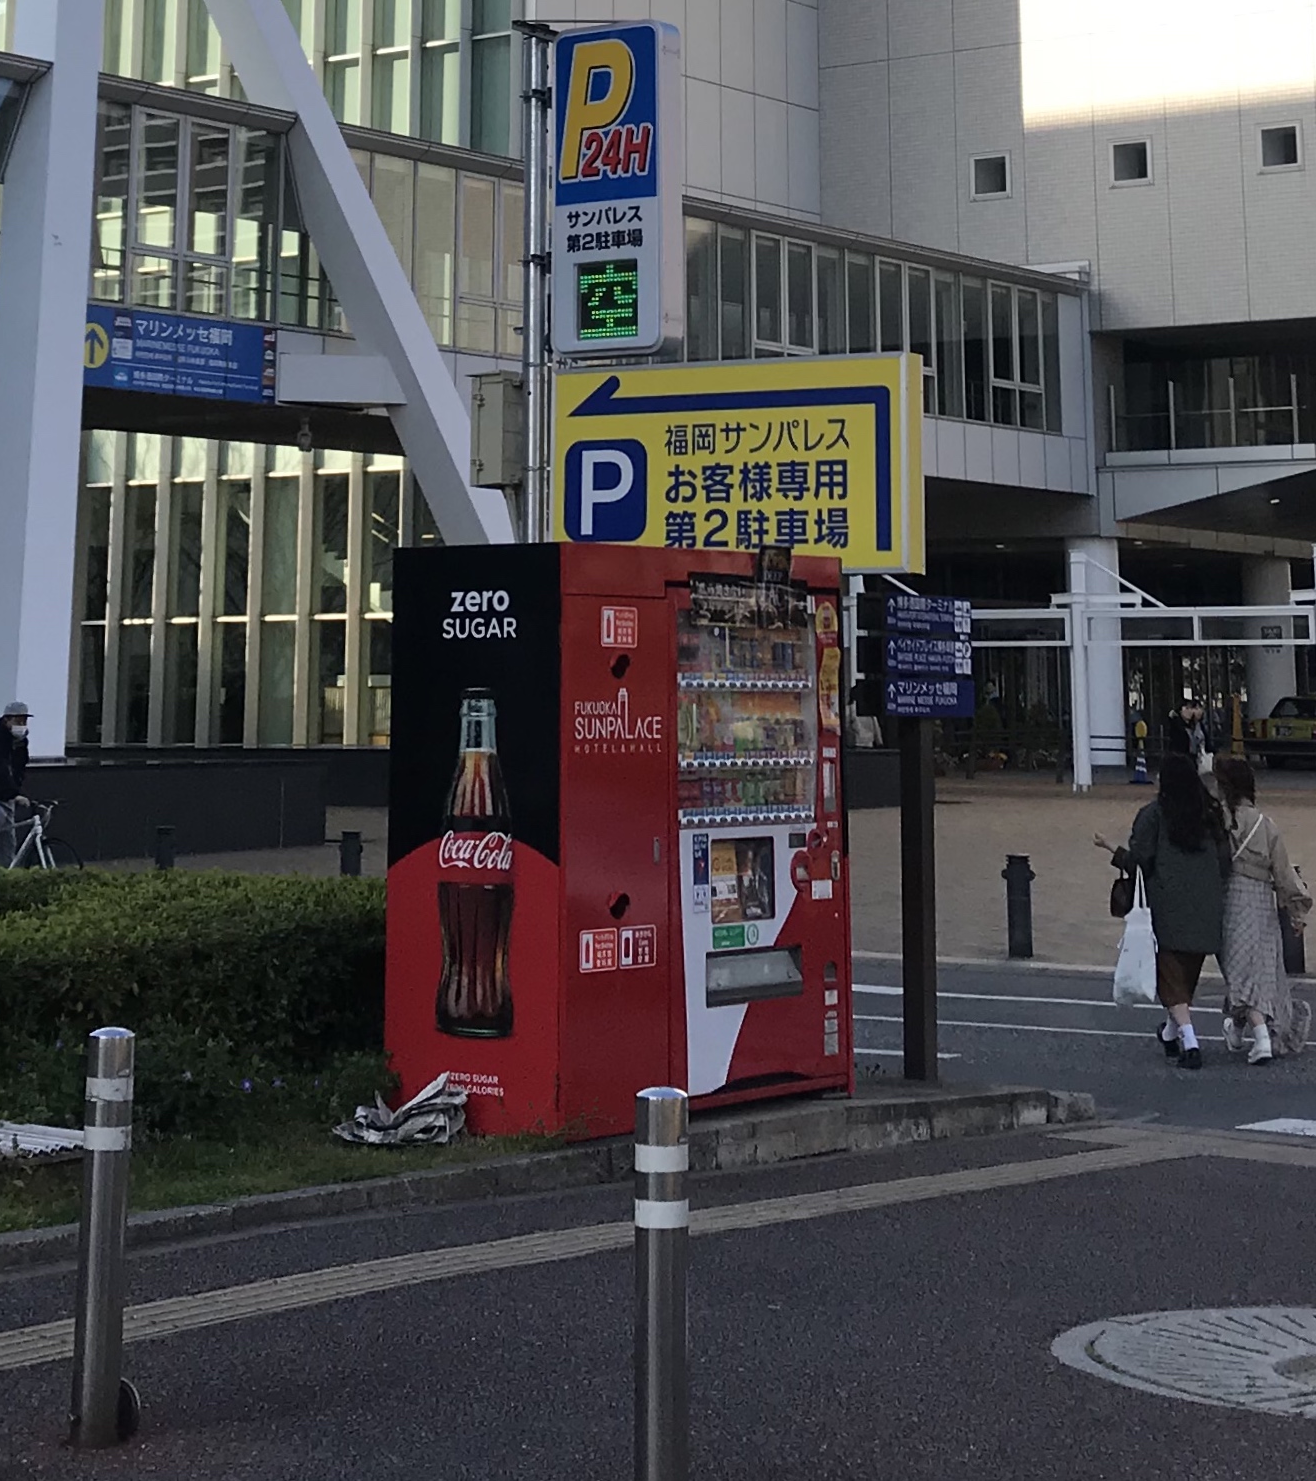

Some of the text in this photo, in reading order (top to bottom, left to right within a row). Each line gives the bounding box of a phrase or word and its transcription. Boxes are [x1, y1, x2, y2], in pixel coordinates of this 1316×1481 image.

[559, 38, 635, 183] P
[581, 122, 652, 180] 24H
[567, 206, 643, 229] サンパレス
[567, 228, 643, 253] 第2駐車場
[580, 264, 637, 338] 空
[136, 319, 233, 346] マリンメッセ福岡
[664, 419, 849, 456] 福岡サンパレス
[580, 449, 633, 535] P
[664, 459, 848, 503] お客様専用
[664, 507, 849, 550] 第2駐車場
[450, 590, 509, 612] zero
[442, 618, 517, 639] SUGAR
[574, 701, 617, 715] FUKUOKA
[574, 715, 661, 740] SUNPALACE
[450, 1072, 499, 1085] ZERO SUGAR
[466, 1084, 504, 1097] CALORIES
